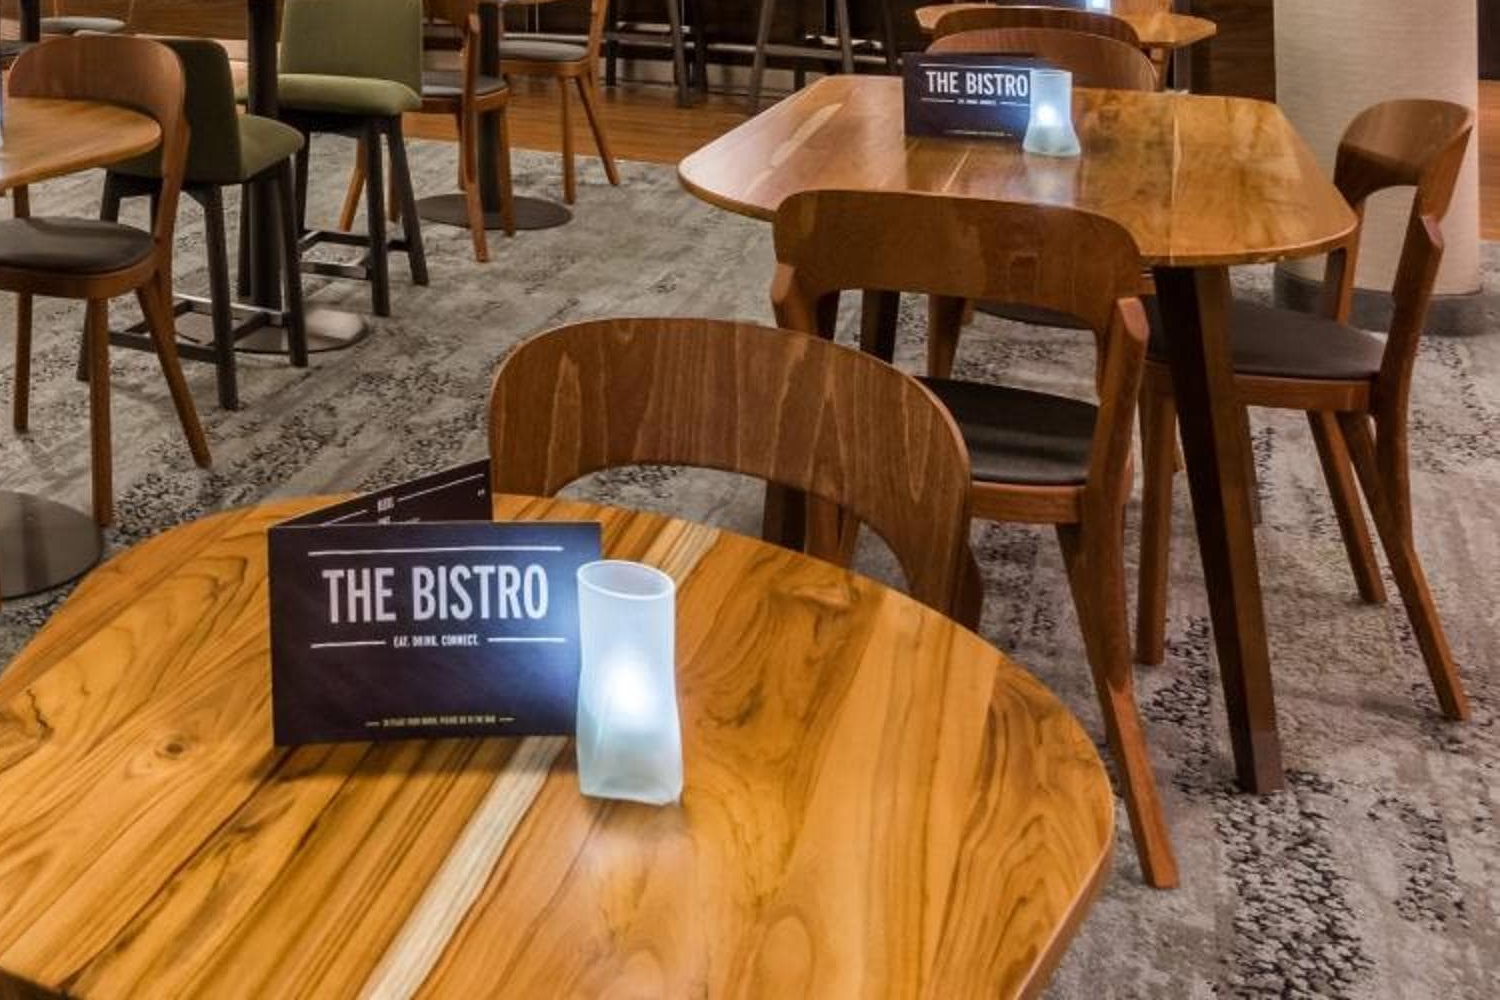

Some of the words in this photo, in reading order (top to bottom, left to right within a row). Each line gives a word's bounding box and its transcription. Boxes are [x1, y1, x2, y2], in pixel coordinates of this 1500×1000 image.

[926, 71, 959, 93] THE
[966, 72, 1028, 97] BISTRO
[322, 567, 396, 624] THE
[412, 564, 550, 622] BISTRO
